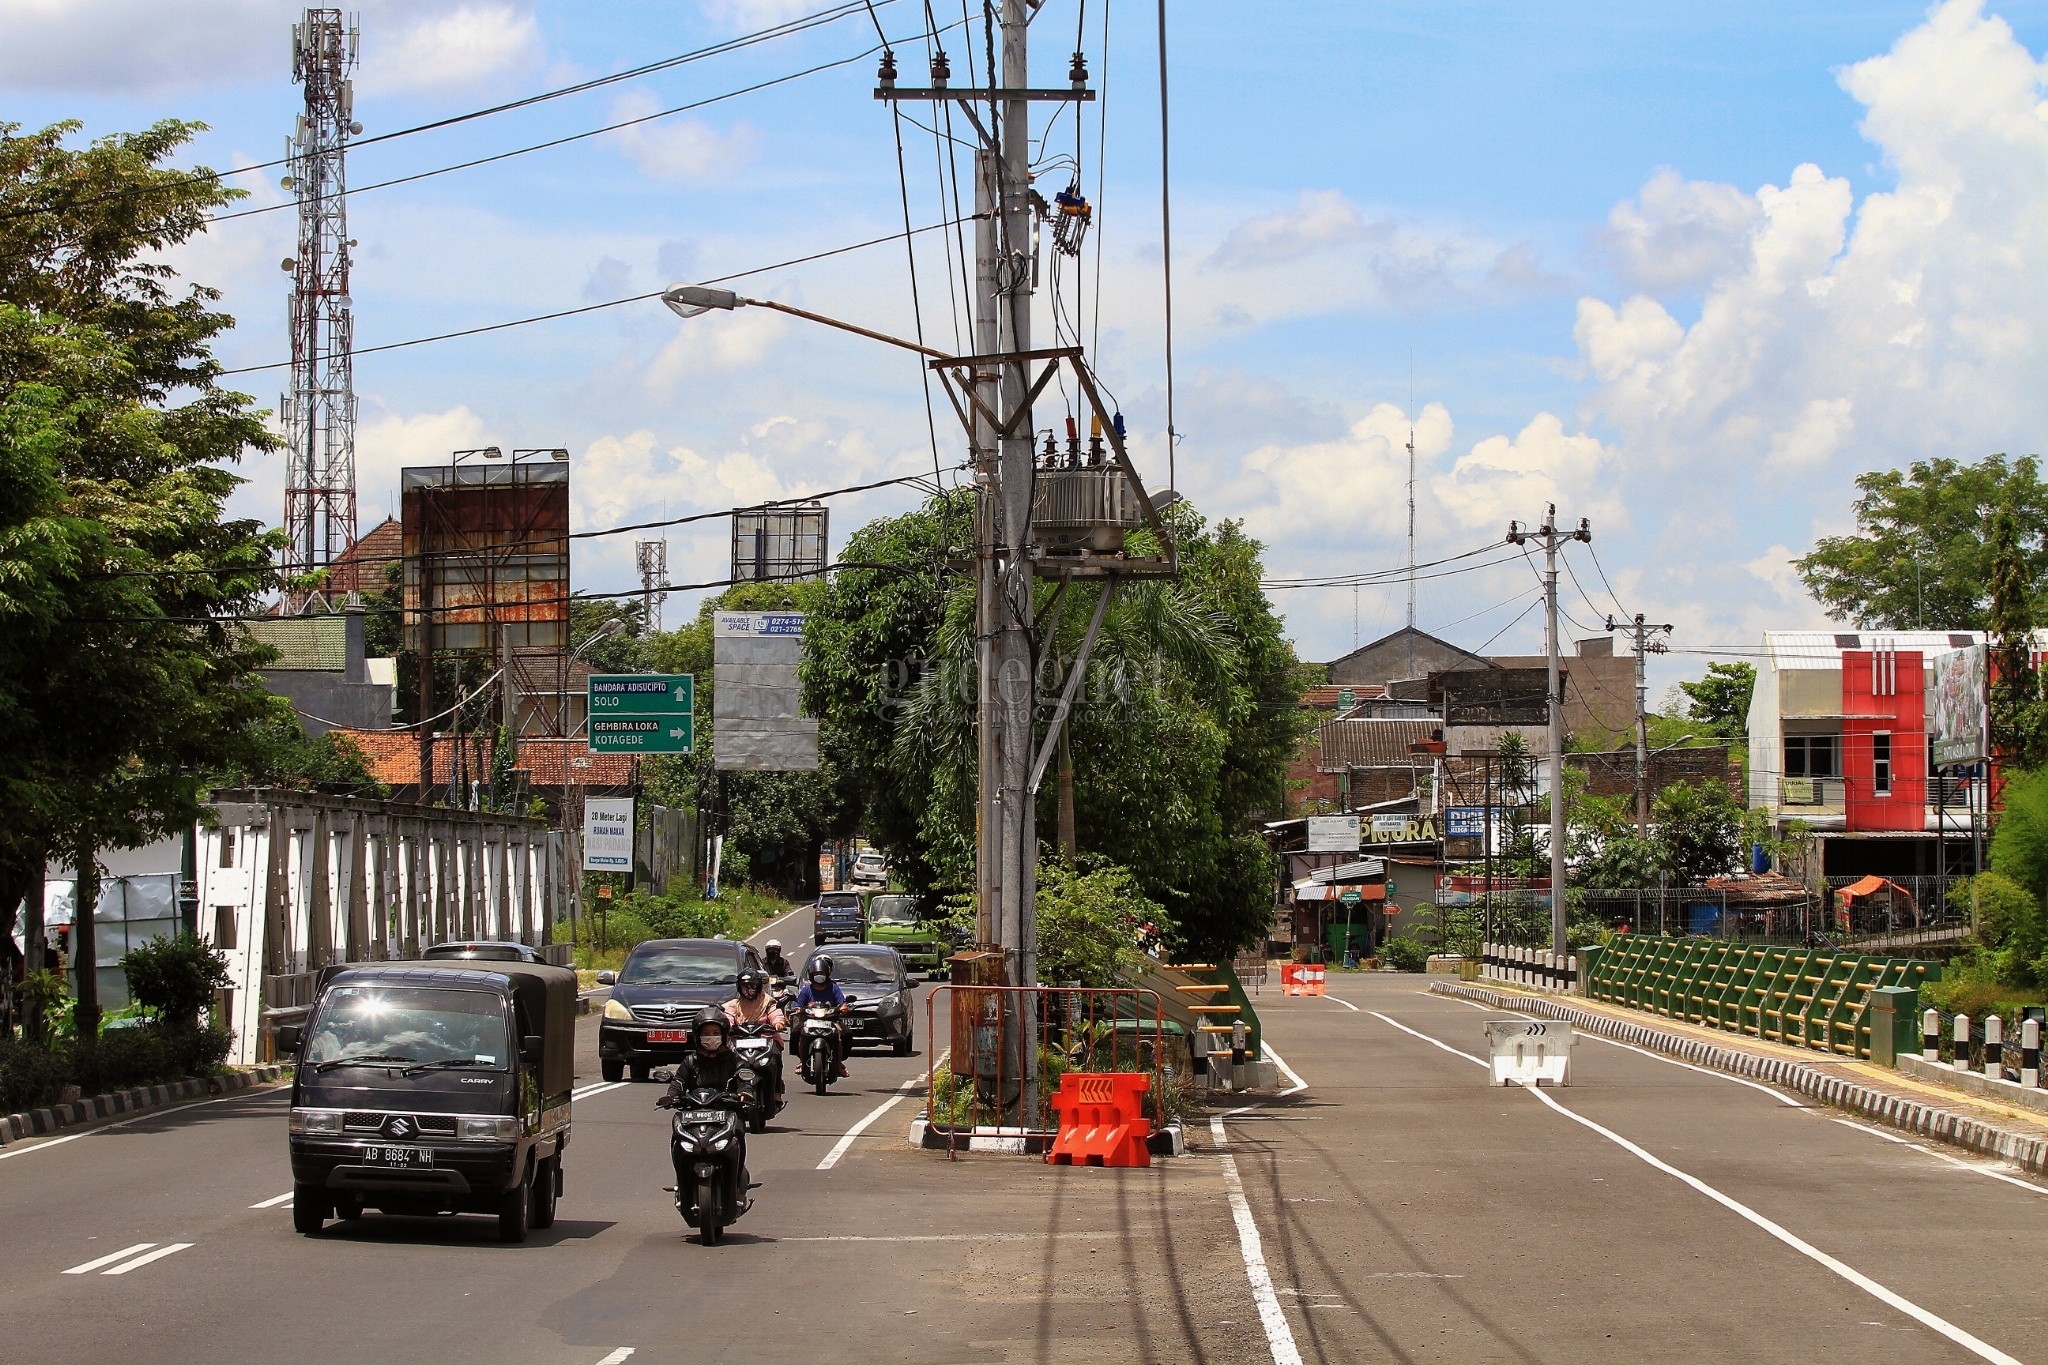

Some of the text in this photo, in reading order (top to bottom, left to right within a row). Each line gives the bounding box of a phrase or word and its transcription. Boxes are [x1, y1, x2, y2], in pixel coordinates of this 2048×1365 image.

[594, 683, 667, 692] BANDARA ADISUCIPTO
[594, 696, 619, 706] SOLO
[594, 722, 658, 731] GEMBIRA LOKA
[595, 735, 643, 744] KOTAGEDE
[591, 812, 628, 824] 20 Meter Lagi
[365, 1148, 432, 1163] AB 8684 NH
